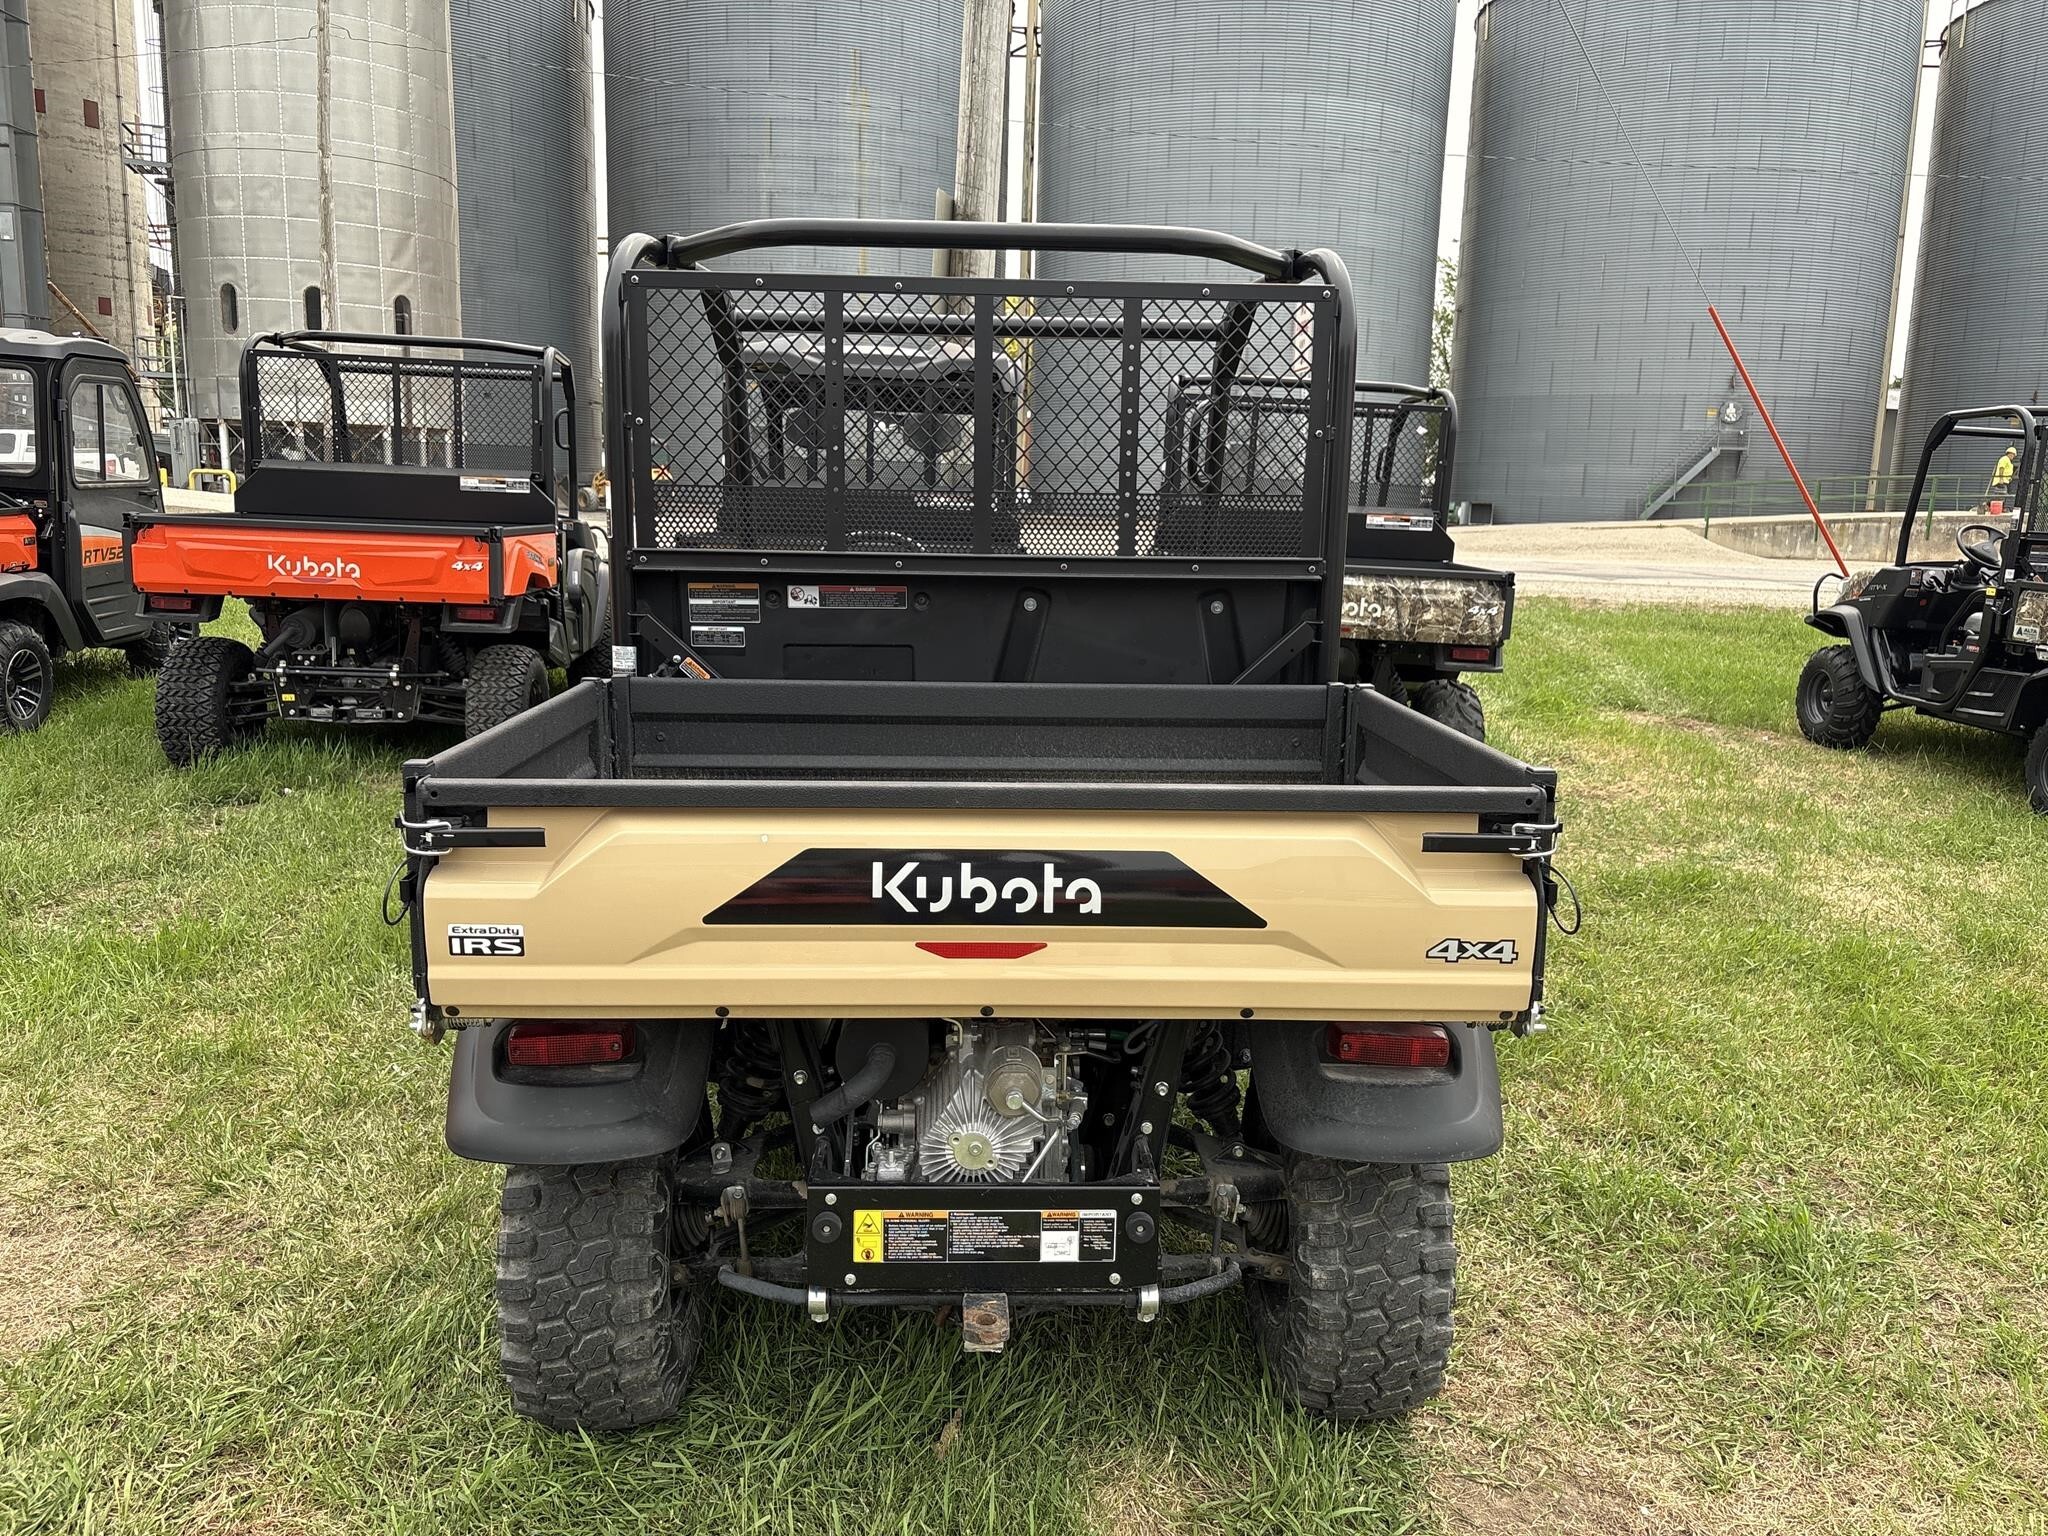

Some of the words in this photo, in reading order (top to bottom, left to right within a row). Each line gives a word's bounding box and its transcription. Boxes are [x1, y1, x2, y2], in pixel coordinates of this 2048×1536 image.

[267, 554, 361, 579] Kubota
[451, 561, 484, 571] 4x4
[1341, 597, 1383, 618] ota
[1467, 604, 1499, 616] 4x4
[872, 861, 1102, 914] Kubota
[451, 926, 487, 935] Extra
[488, 926, 520, 936] Duty
[451, 937, 522, 955] IRS
[1426, 938, 1518, 964] 4x4
